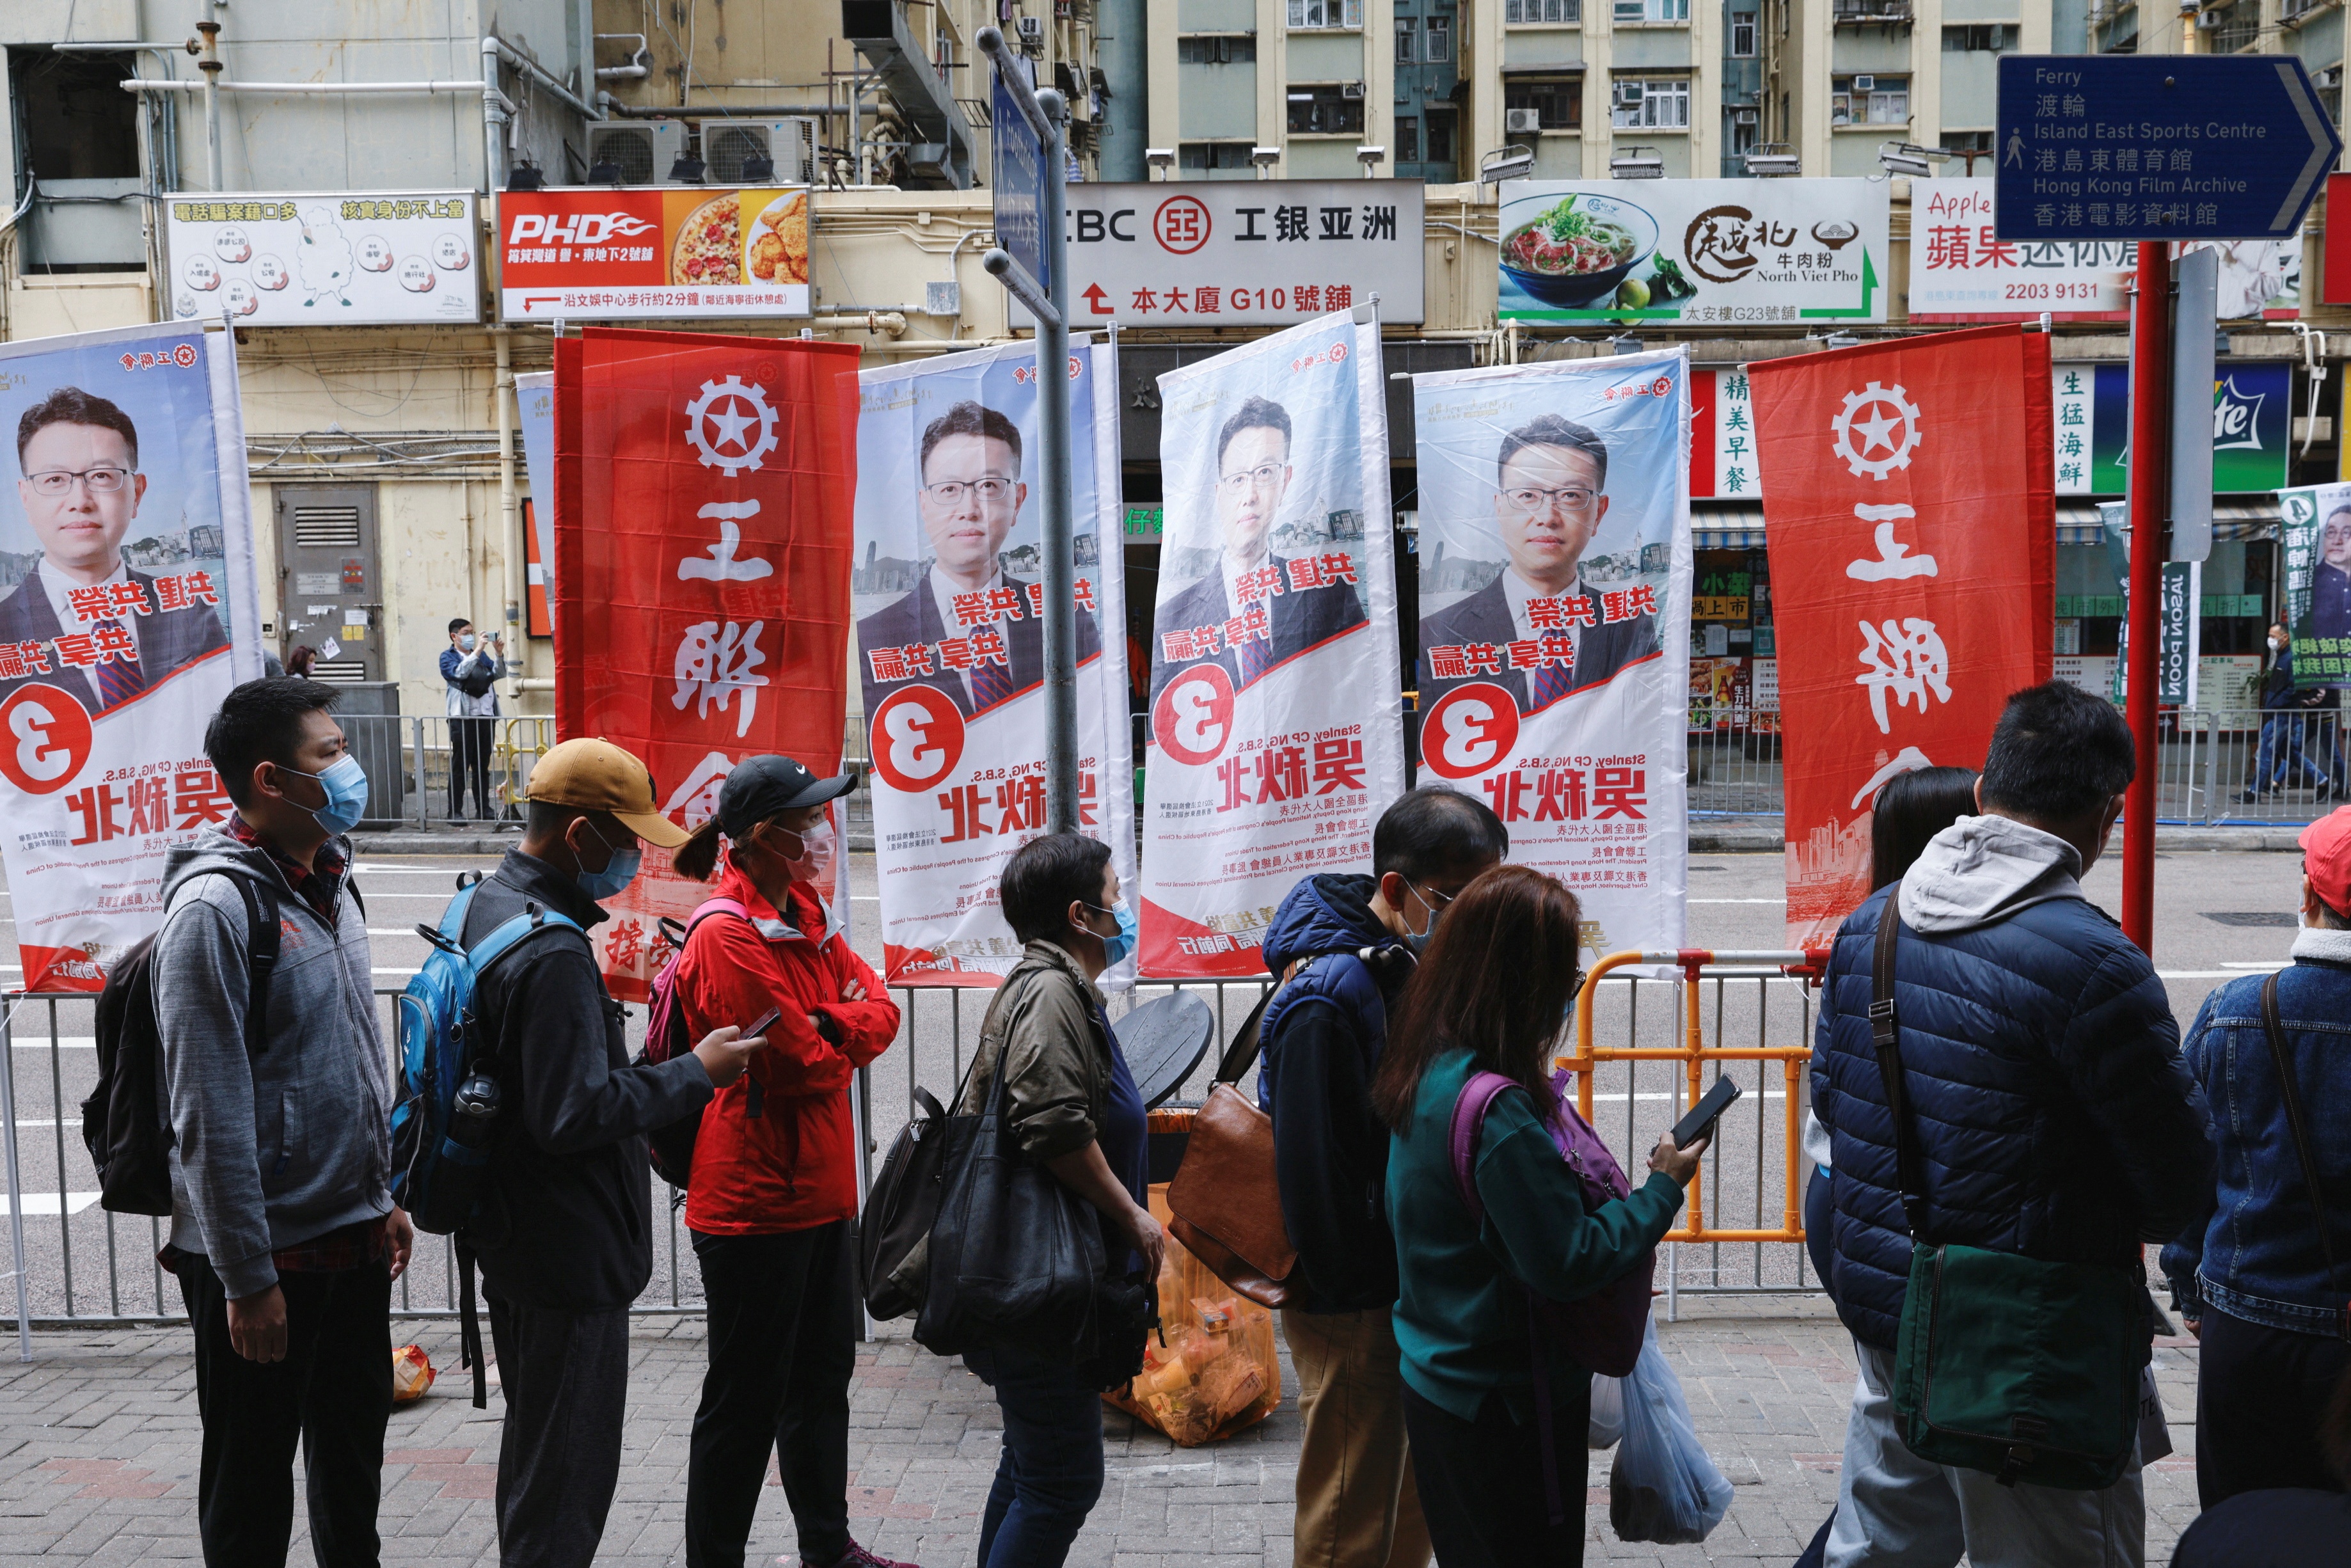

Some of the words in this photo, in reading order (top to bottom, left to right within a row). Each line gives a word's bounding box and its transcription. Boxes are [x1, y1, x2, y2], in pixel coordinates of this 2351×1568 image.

[2036, 68, 2082, 87] Ferry
[2035, 93, 2086, 117] 渡輪
[2034, 123, 2088, 139] Island
[2095, 124, 2133, 139] East
[2141, 122, 2199, 141] Sports
[2206, 122, 2267, 139] Centre
[1006, 109, 1038, 190] Footbridge
[2034, 148, 2192, 172] 港島東體育館
[2034, 178, 2080, 196] Hong
[2088, 178, 2132, 196] Kong
[2139, 178, 2174, 193] Film
[2181, 177, 2247, 193] Archive
[174, 202, 297, 221] 電話騙案藉口多
[341, 200, 464, 220] 核實身份不上當
[1928, 191, 1991, 219] Apple
[2034, 203, 2218, 226] 香港電影資料館
[509, 212, 612, 244] PHD
[1066, 209, 1136, 242] BC
[1235, 205, 1397, 242] 工银亚洲
[1777, 253, 1832, 269] 牛肉粉
[1757, 270, 1797, 282] North
[1801, 271, 1829, 281] Viet
[1832, 271, 1858, 281] Pho
[1132, 287, 1221, 313] 本大廈
[1231, 288, 1286, 310] G10
[1293, 285, 1352, 313] 號舖
[2006, 283, 2049, 299] 2203
[2056, 283, 2098, 299] 9131
[1686, 305, 1796, 321] 太安樓G23號舖
[1724, 376, 1749, 492] 精美早餐
[2057, 372, 2084, 486] 生猛海鮮
